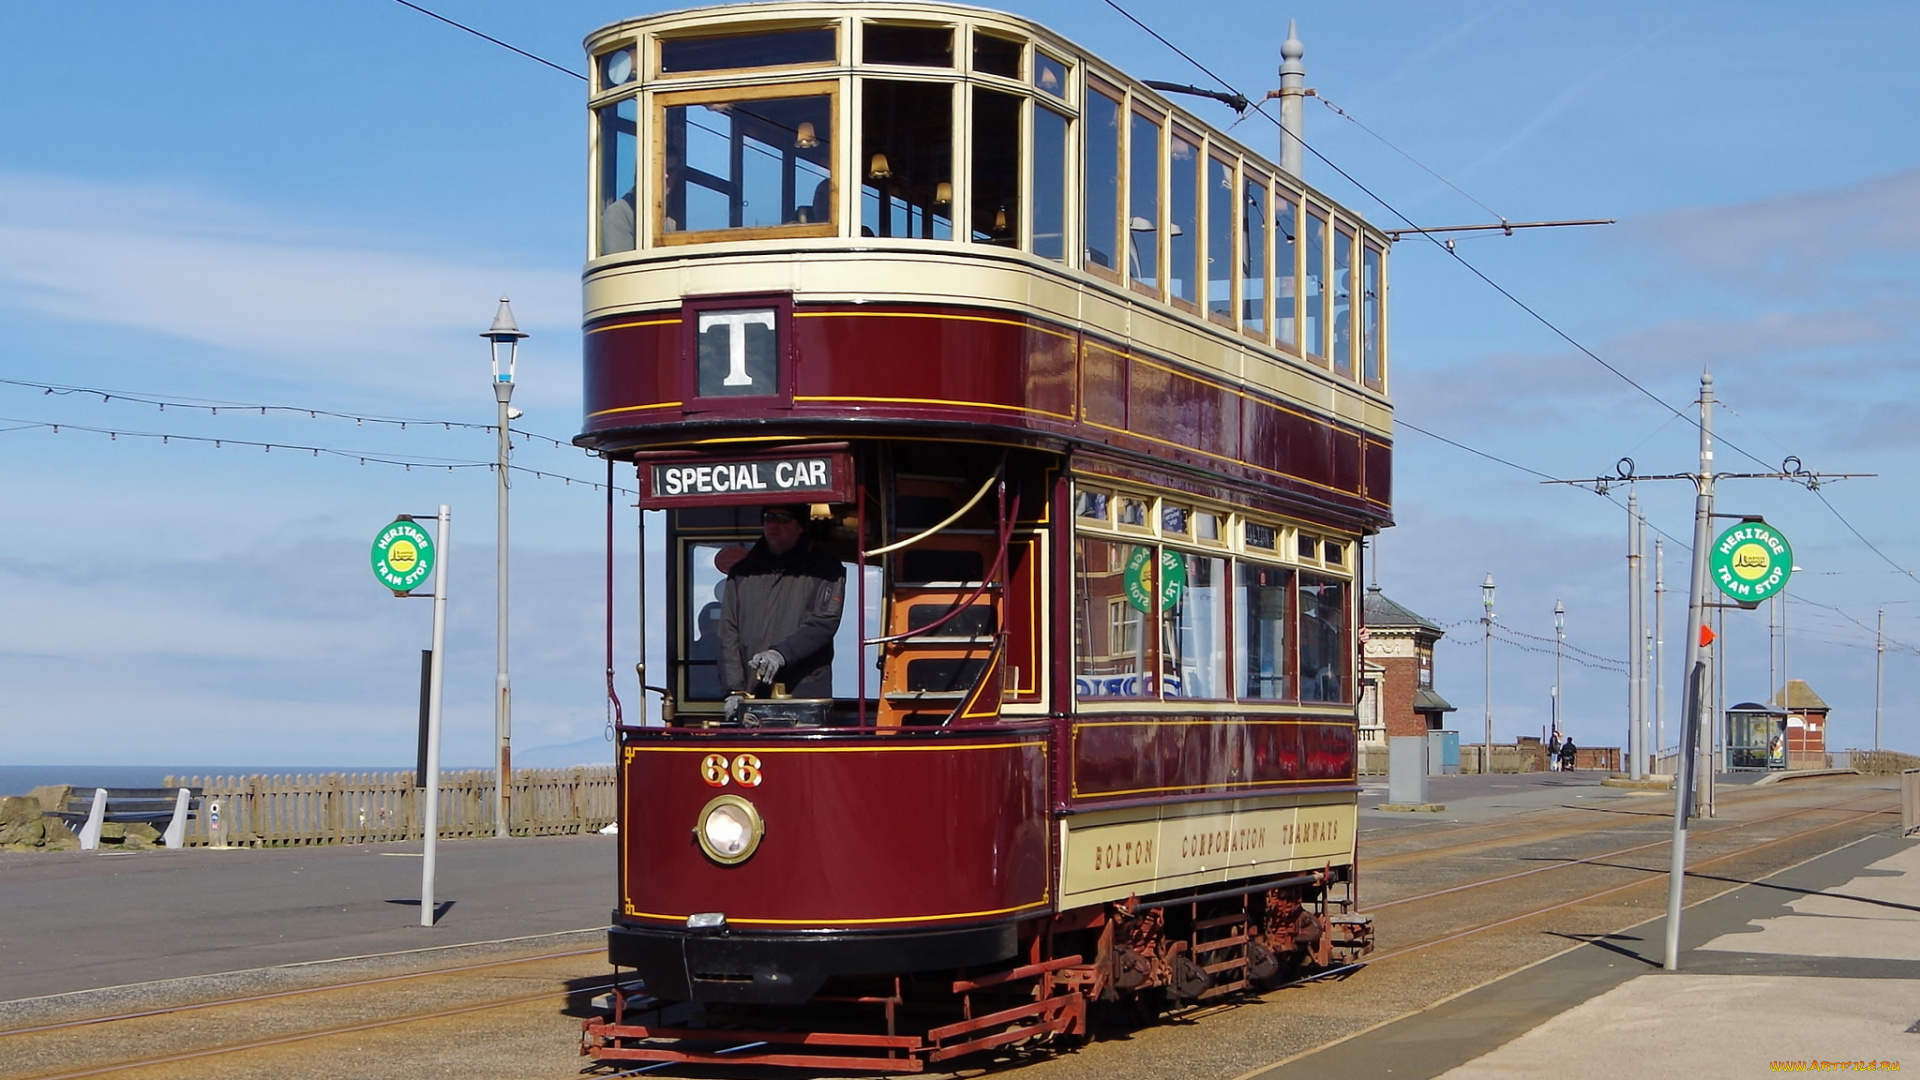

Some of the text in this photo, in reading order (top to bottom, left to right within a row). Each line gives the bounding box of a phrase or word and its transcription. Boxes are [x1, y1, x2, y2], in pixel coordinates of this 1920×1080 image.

[699, 311, 775, 386] T
[665, 459, 827, 495] SPECIAL CAR
[378, 525, 428, 550] HERITAGE
[1719, 527, 1785, 555] HERITAGE
[377, 559, 427, 585] TRAM STOP
[1718, 564, 1783, 595] TRAM STOP
[701, 753, 763, 788] 66
[1095, 820, 1339, 871] BOLTON CORPORATION TRAMWAYS
